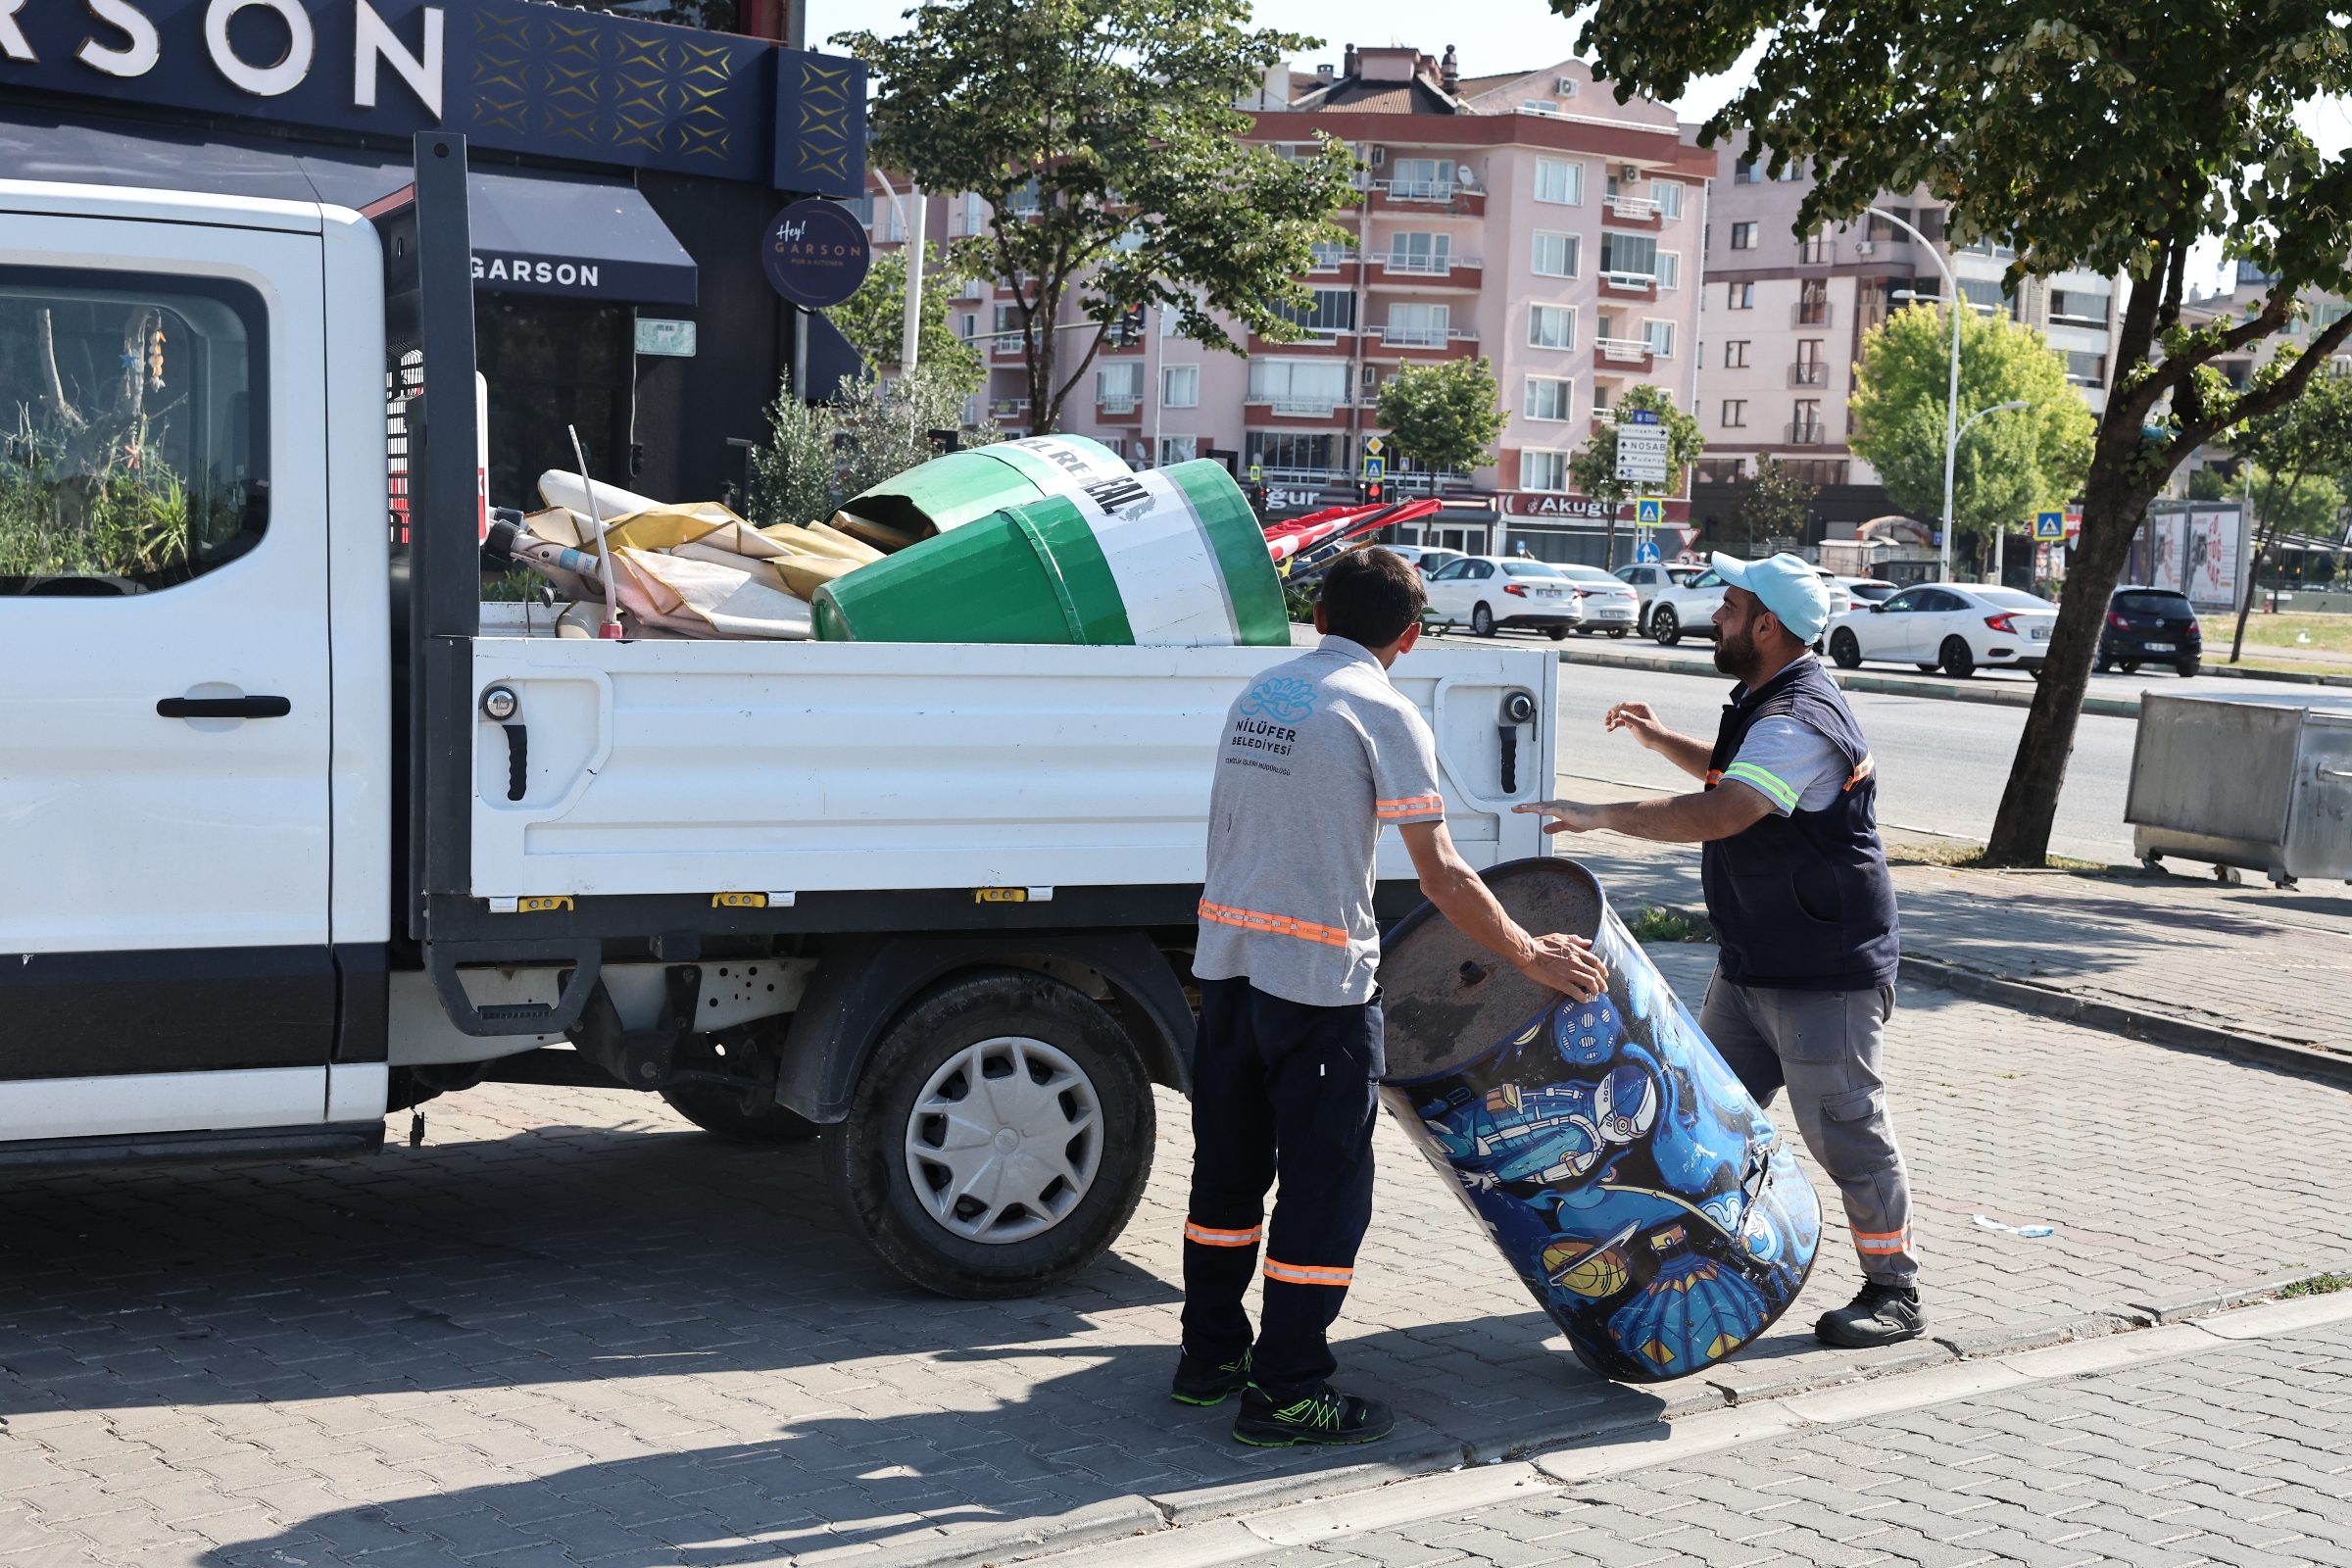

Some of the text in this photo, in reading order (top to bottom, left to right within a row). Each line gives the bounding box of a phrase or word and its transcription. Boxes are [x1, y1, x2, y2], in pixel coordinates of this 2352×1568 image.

[776, 220, 807, 242] Hey!
[774, 242, 860, 256] GARSON
[470, 257, 598, 287] GARSON
[1631, 441, 1666, 452] NOSAB
[1236, 717, 1297, 742] NİLÜFER
[1232, 737, 1292, 756] BELEDİYESİ
